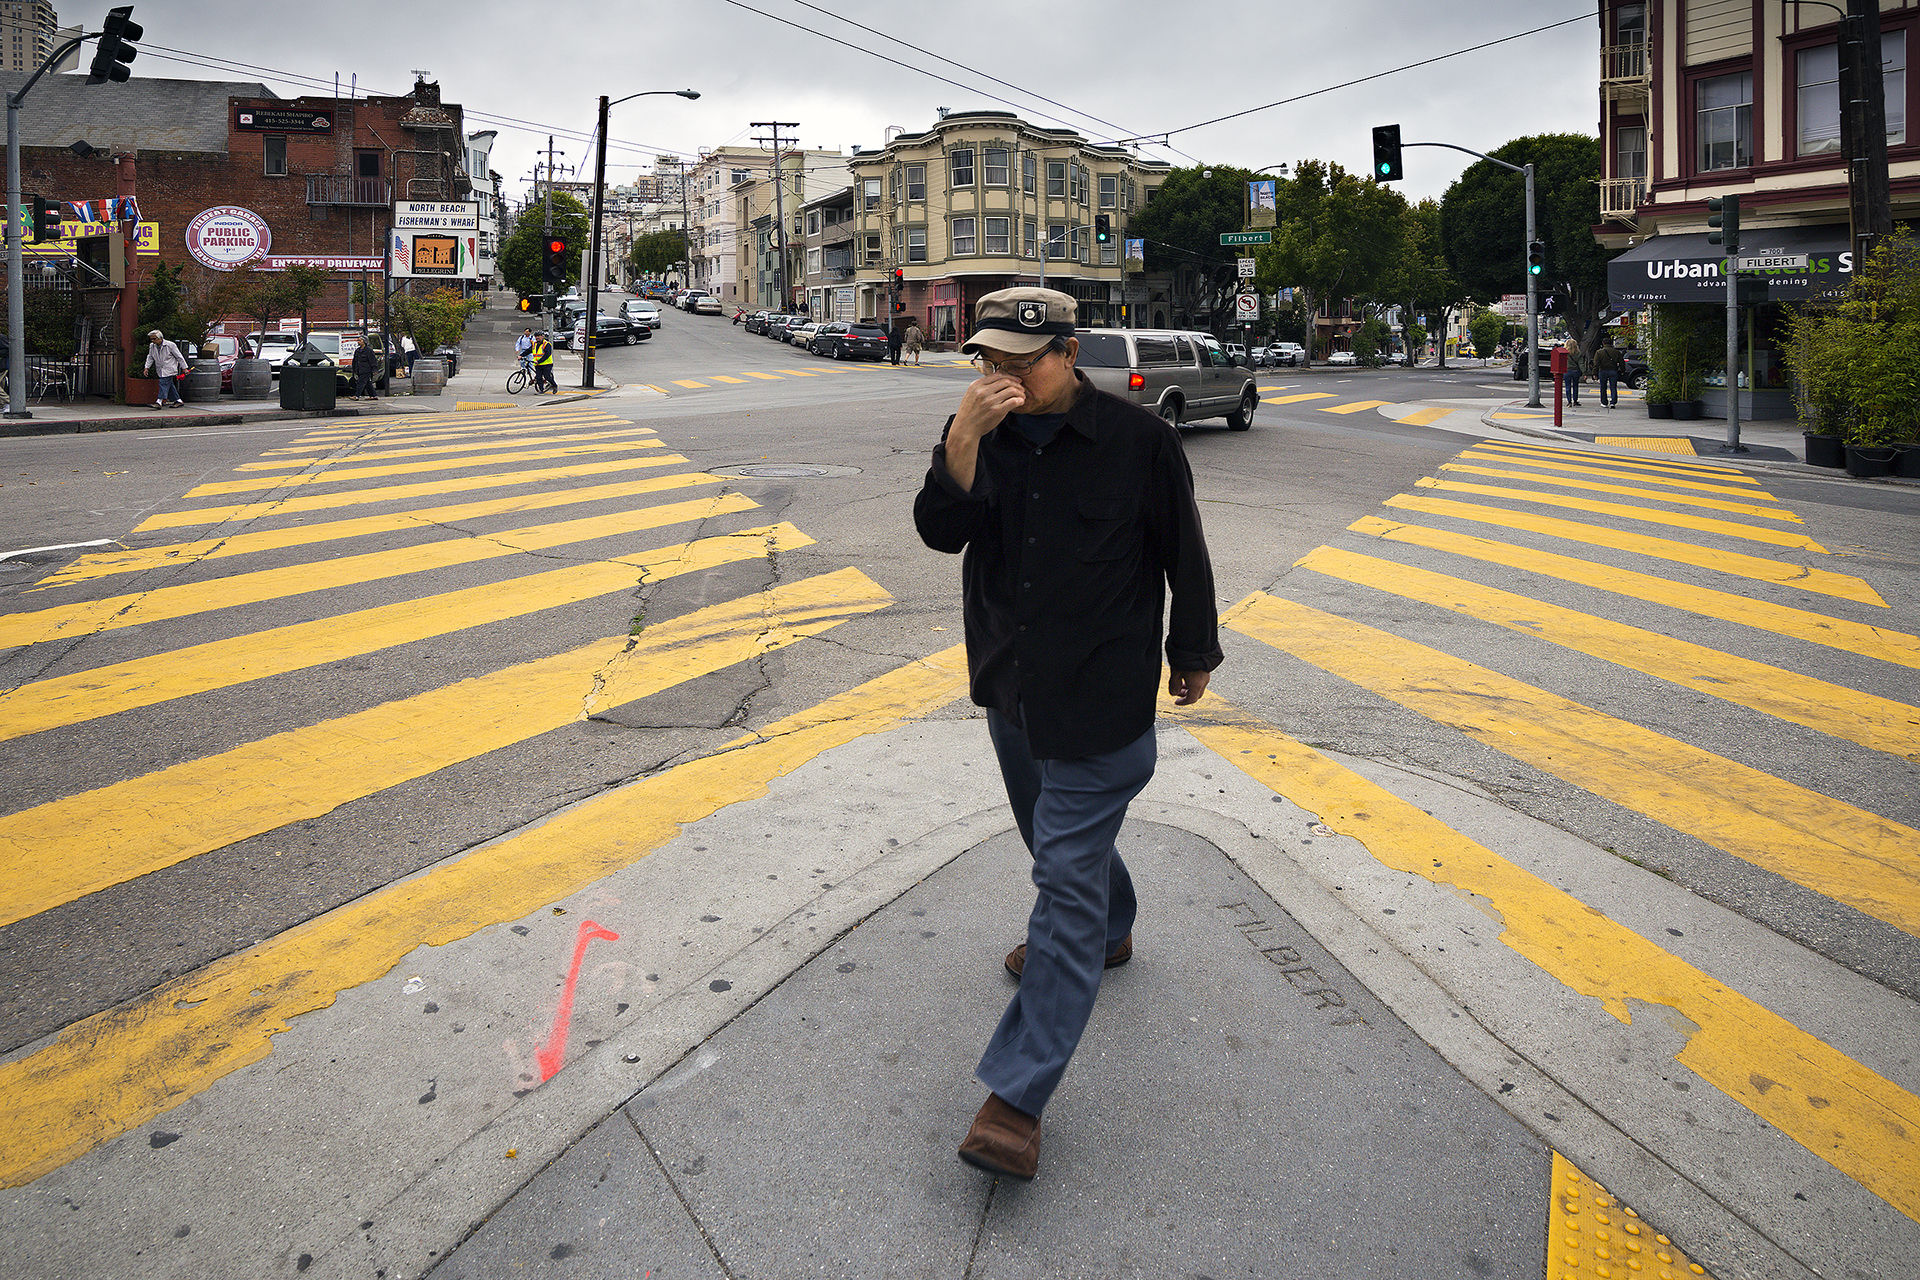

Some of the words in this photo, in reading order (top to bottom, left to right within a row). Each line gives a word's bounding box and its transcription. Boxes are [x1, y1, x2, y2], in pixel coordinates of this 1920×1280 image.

[409, 203, 435, 212] NORTH
[440, 204, 466, 212] BEACH
[193, 209, 227, 230] FILBERT
[229, 209, 265, 231] GARAGE
[398, 216, 448, 226] FISHERMAN'S
[450, 218, 475, 227] WHARF
[207, 228, 250, 237] PUBLIC
[203, 237, 255, 247] PARKING
[192, 247, 229, 268] GARAGE
[1746, 257, 1797, 267] FILBERT
[272, 259, 305, 267] ENTER
[327, 260, 383, 268] DRIVEWAY
[1240, 268, 1254, 276] 25
[1768, 278, 1808, 286] dening
[1216, 902, 1375, 1030] FILBERT
